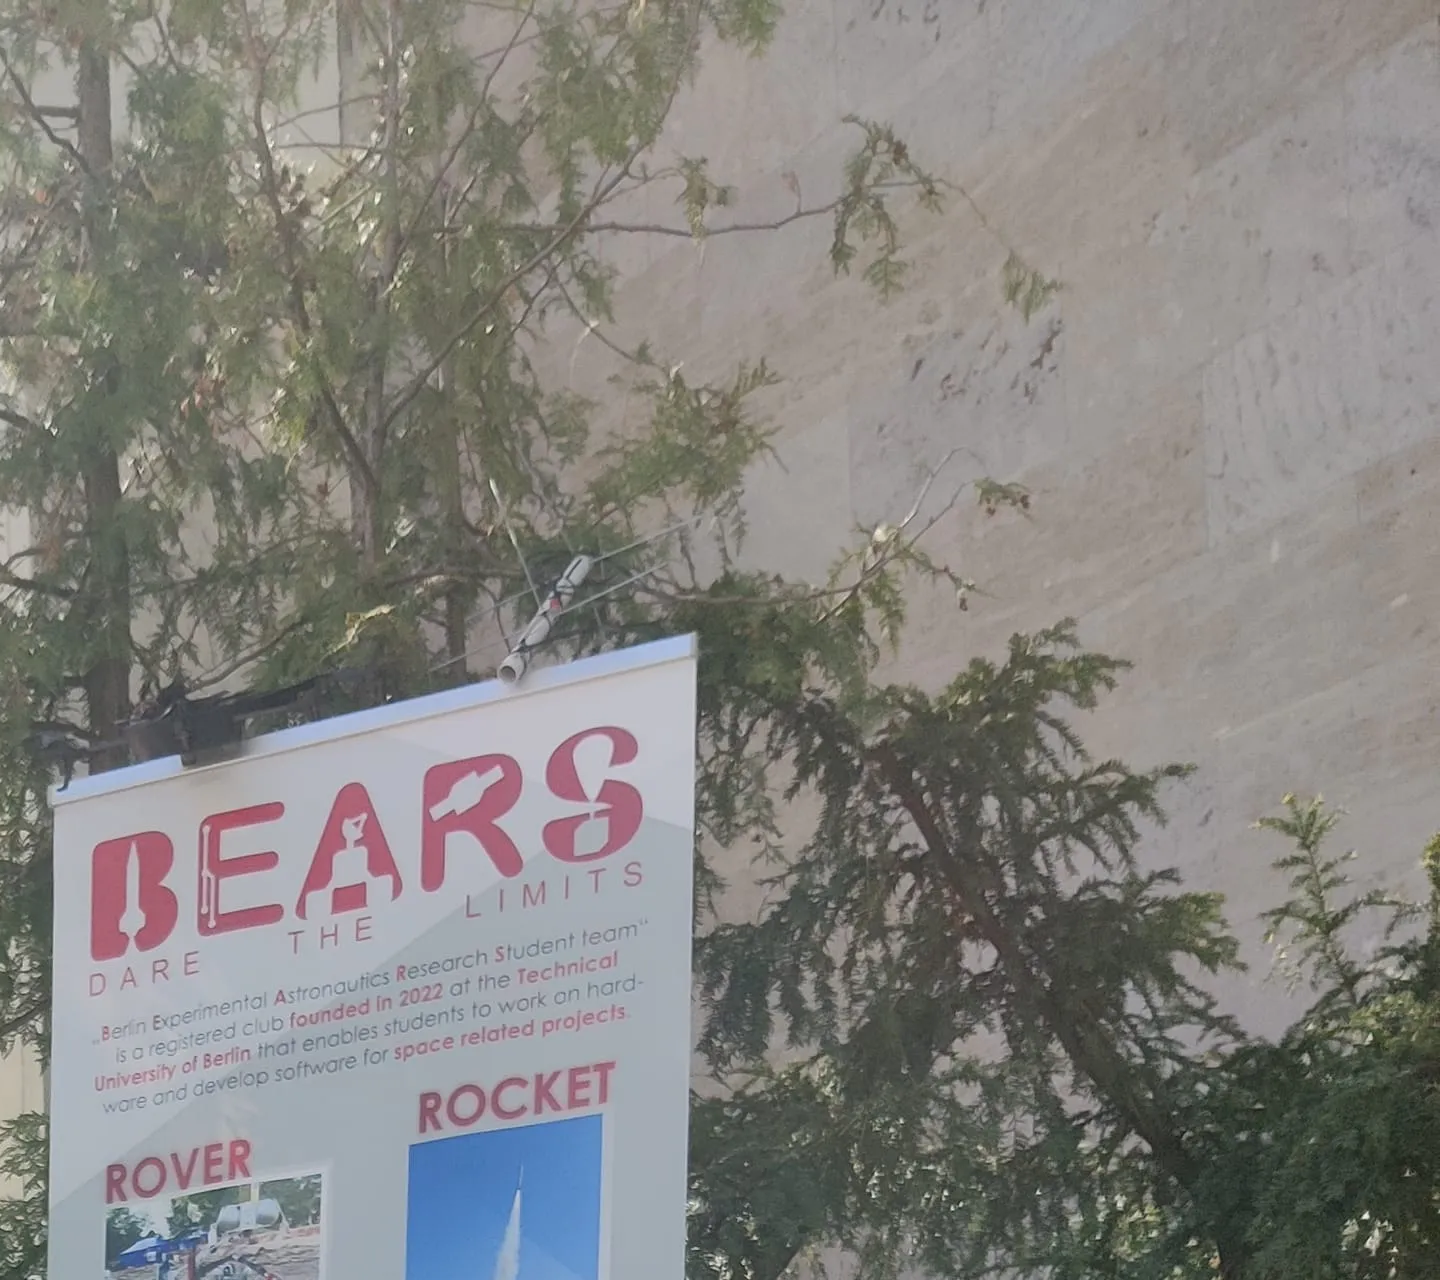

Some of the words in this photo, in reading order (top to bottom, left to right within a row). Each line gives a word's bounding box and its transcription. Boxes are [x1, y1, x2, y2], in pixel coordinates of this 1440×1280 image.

[91, 726, 643, 960] BEARS
[89, 951, 200, 996] DARE
[288, 916, 372, 954] THE
[466, 861, 643, 918] LIMITS
[94, 1061, 177, 1091] University
[182, 1055, 197, 1074] of
[203, 1046, 251, 1070] Berlin
[258, 1038, 296, 1059] that
[302, 1024, 378, 1052] enables
[384, 1005, 465, 1037] students
[472, 1002, 491, 1019] to
[498, 992, 547, 1013] work
[553, 988, 580, 1005] on
[587, 974, 644, 999] hard-
[115, 1048, 127, 1063] is
[132, 1045, 144, 1061] a
[149, 1023, 236, 1058] registered
[242, 1015, 284, 1037] club
[289, 999, 370, 1029] founded
[376, 995, 392, 1012] in
[399, 983, 443, 1008] 2022
[450, 980, 469, 998] at
[478, 972, 510, 993] the
[517, 951, 618, 985] Technical
[153, 992, 268, 1031] Experimental
[274, 971, 390, 1005] Astronautics
[396, 950, 488, 982] Research
[495, 933, 574, 962] Student
[102, 1094, 147, 1114] ware
[152, 1084, 188, 1106] and
[193, 1066, 269, 1098] develop
[274, 1053, 357, 1083] software
[363, 1048, 389, 1066] for
[394, 1033, 455, 1062] space
[461, 1019, 535, 1047] related
[417, 1061, 617, 1133] ROCKET
[106, 1139, 252, 1204] ROVER
